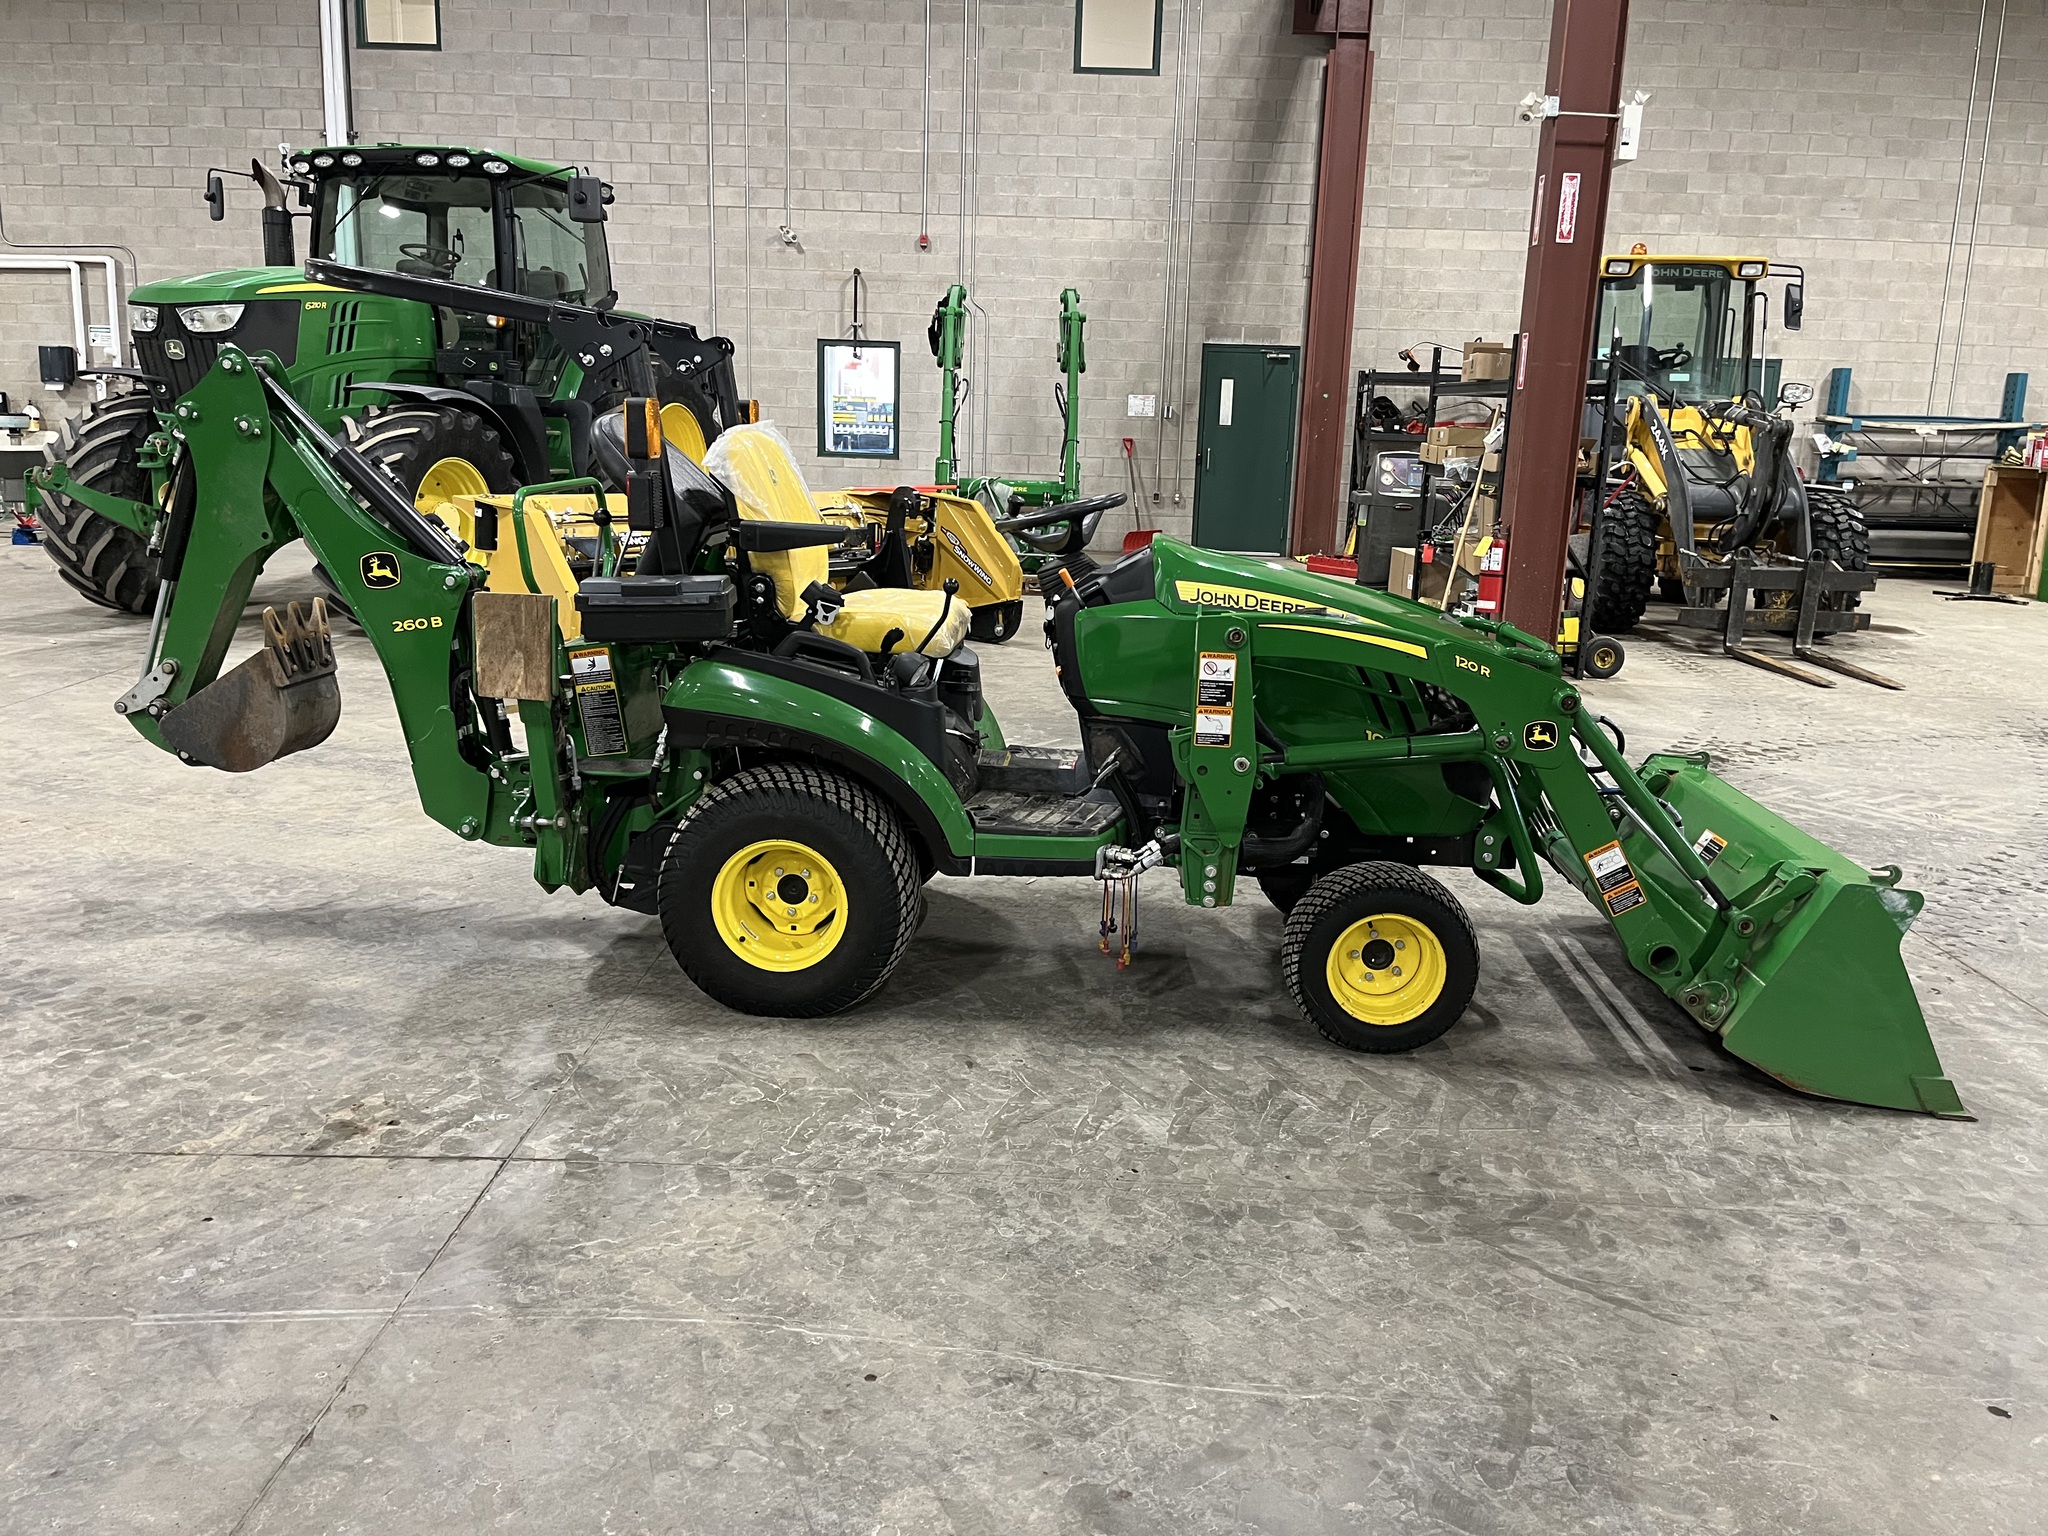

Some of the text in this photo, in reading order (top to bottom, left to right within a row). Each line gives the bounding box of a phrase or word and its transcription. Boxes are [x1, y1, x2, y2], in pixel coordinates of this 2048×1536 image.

[1650, 267, 1724, 279] OHN DEERE
[1650, 418, 1669, 461] 244K
[953, 544, 993, 587] SNOWWING
[1189, 587, 1240, 607] JOHN
[391, 615, 443, 633] 260 B
[578, 649, 605, 657] WARNING
[1454, 654, 1491, 678] 120 R
